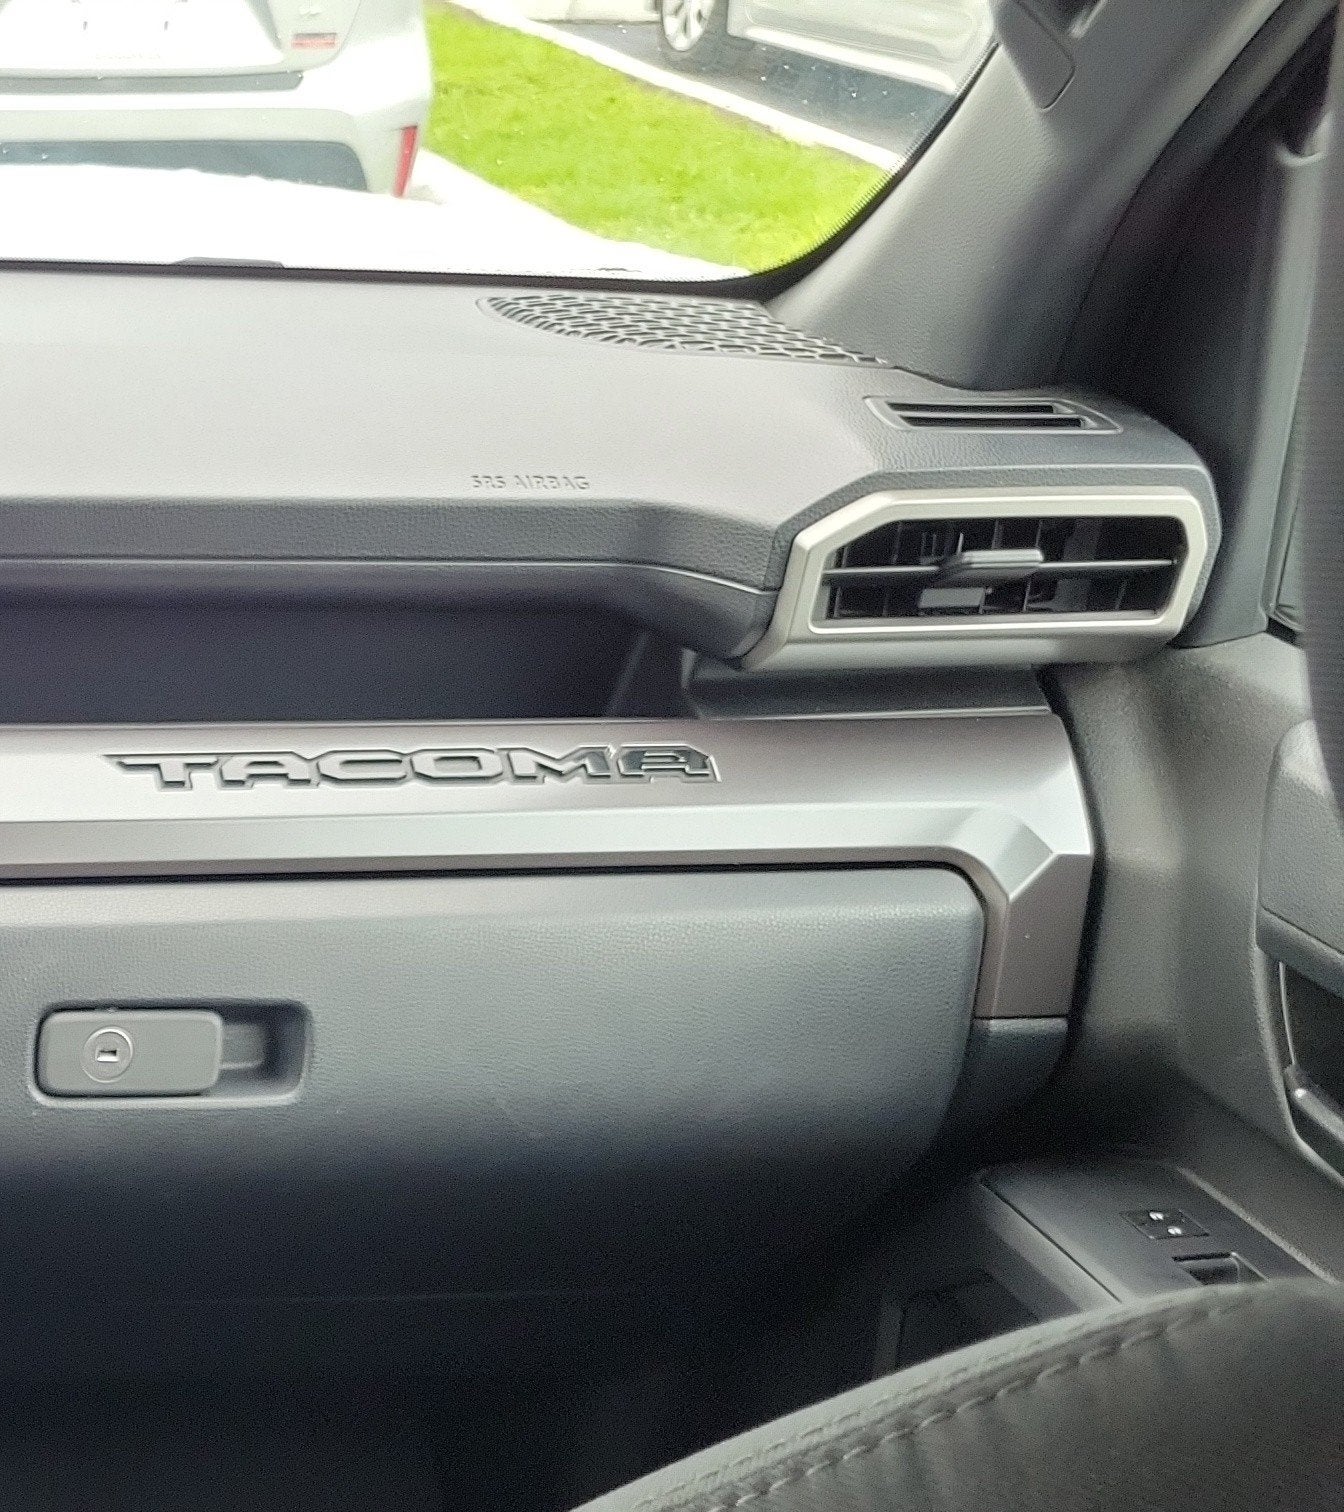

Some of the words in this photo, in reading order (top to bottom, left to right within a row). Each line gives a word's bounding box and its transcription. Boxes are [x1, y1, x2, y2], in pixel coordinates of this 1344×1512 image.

[470, 475, 507, 489] SRS
[514, 475, 591, 490] AIRBAG
[103, 744, 722, 790] TACOMA
